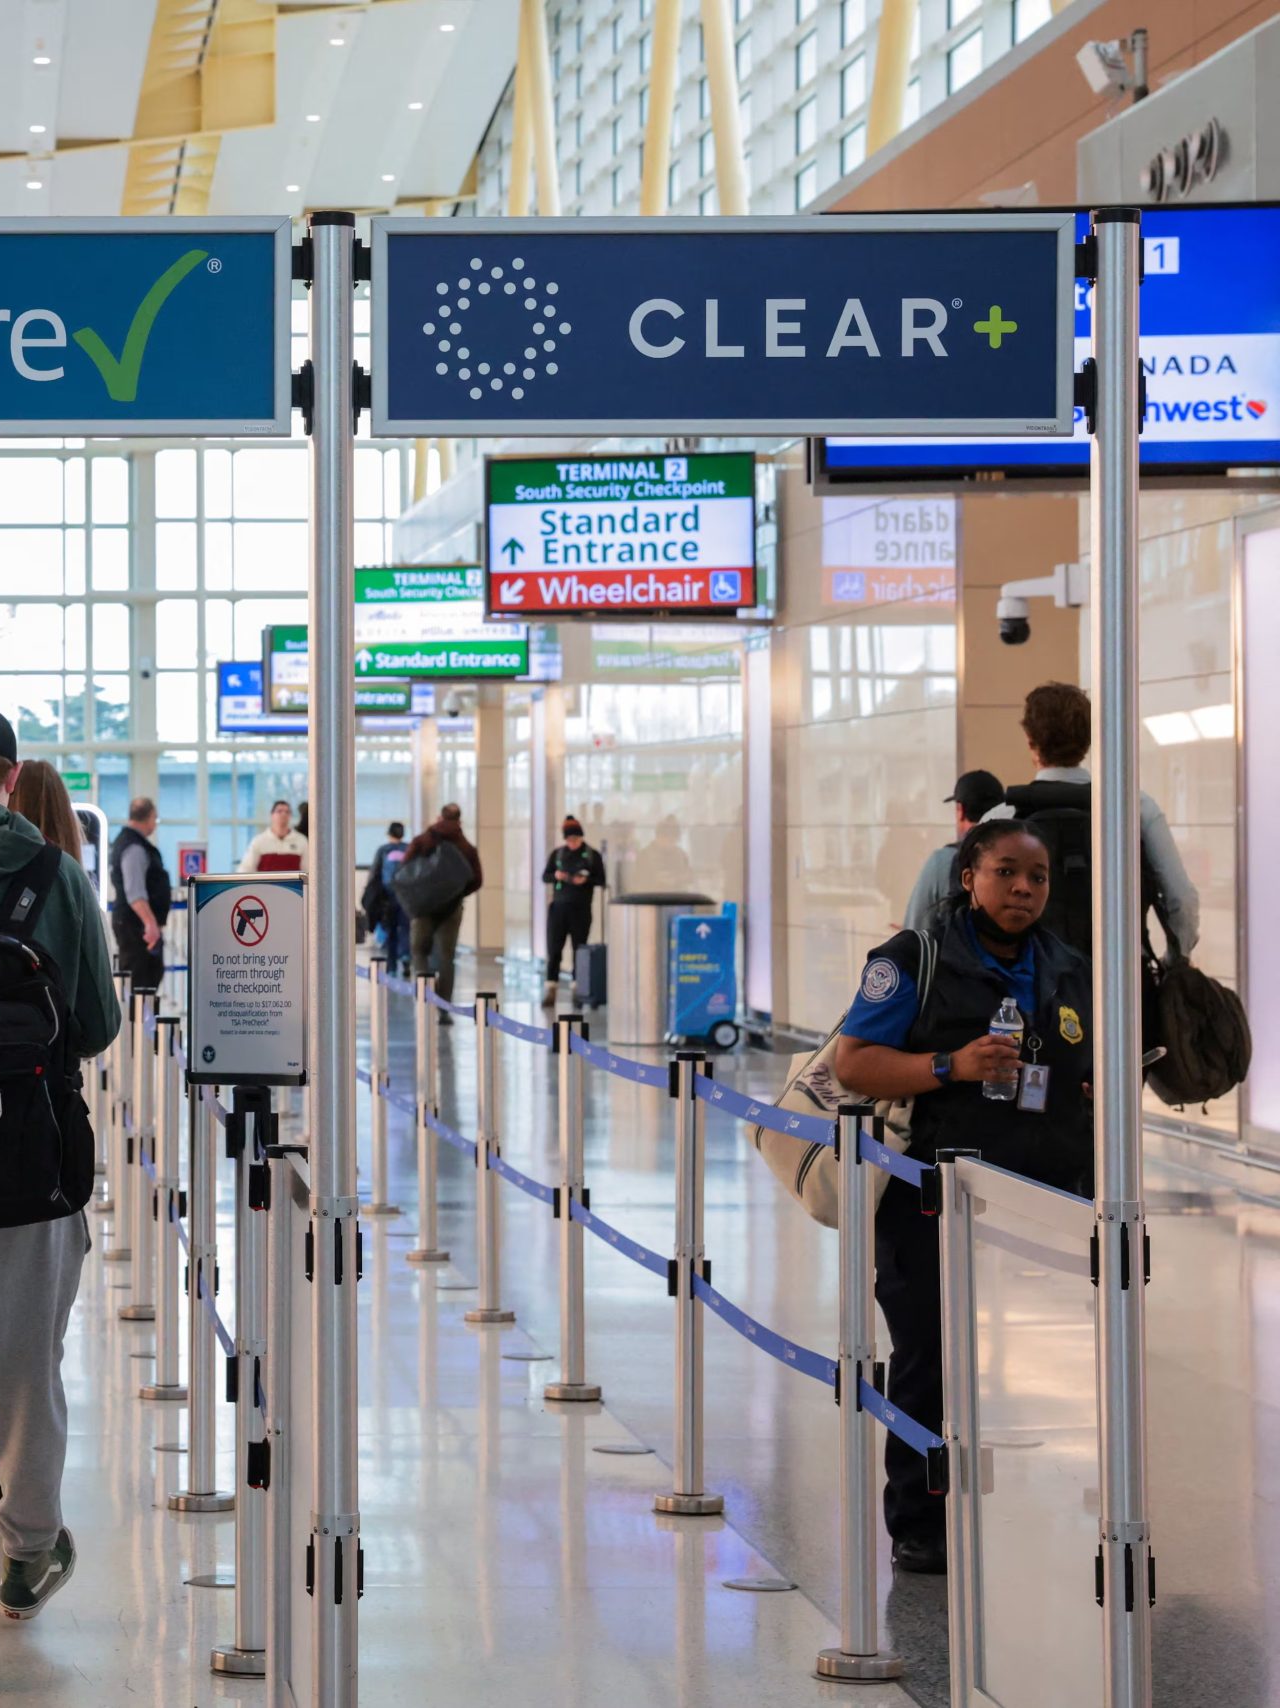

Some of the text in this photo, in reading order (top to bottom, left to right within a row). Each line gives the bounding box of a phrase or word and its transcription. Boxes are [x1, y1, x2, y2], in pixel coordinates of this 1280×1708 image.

[1152, 243, 1166, 269] 1
[1141, 354, 1238, 376] NADA
[1145, 393, 1244, 422] hwest
[556, 461, 660, 482] TERMINAL
[515, 479, 725, 501] South Security Checkpoint
[540, 504, 700, 536] Standard
[543, 538, 699, 565] Entrance
[393, 572, 463, 586] TERMINAL
[538, 574, 704, 605] Wheelchair
[364, 587, 398, 599] South
[399, 586, 443, 600] Security
[375, 651, 521, 669] Standard Entrance
[212, 953, 288, 966] Do not bring your
[216, 968, 285, 980] firearm through
[218, 982, 283, 994] the checkpoint.
